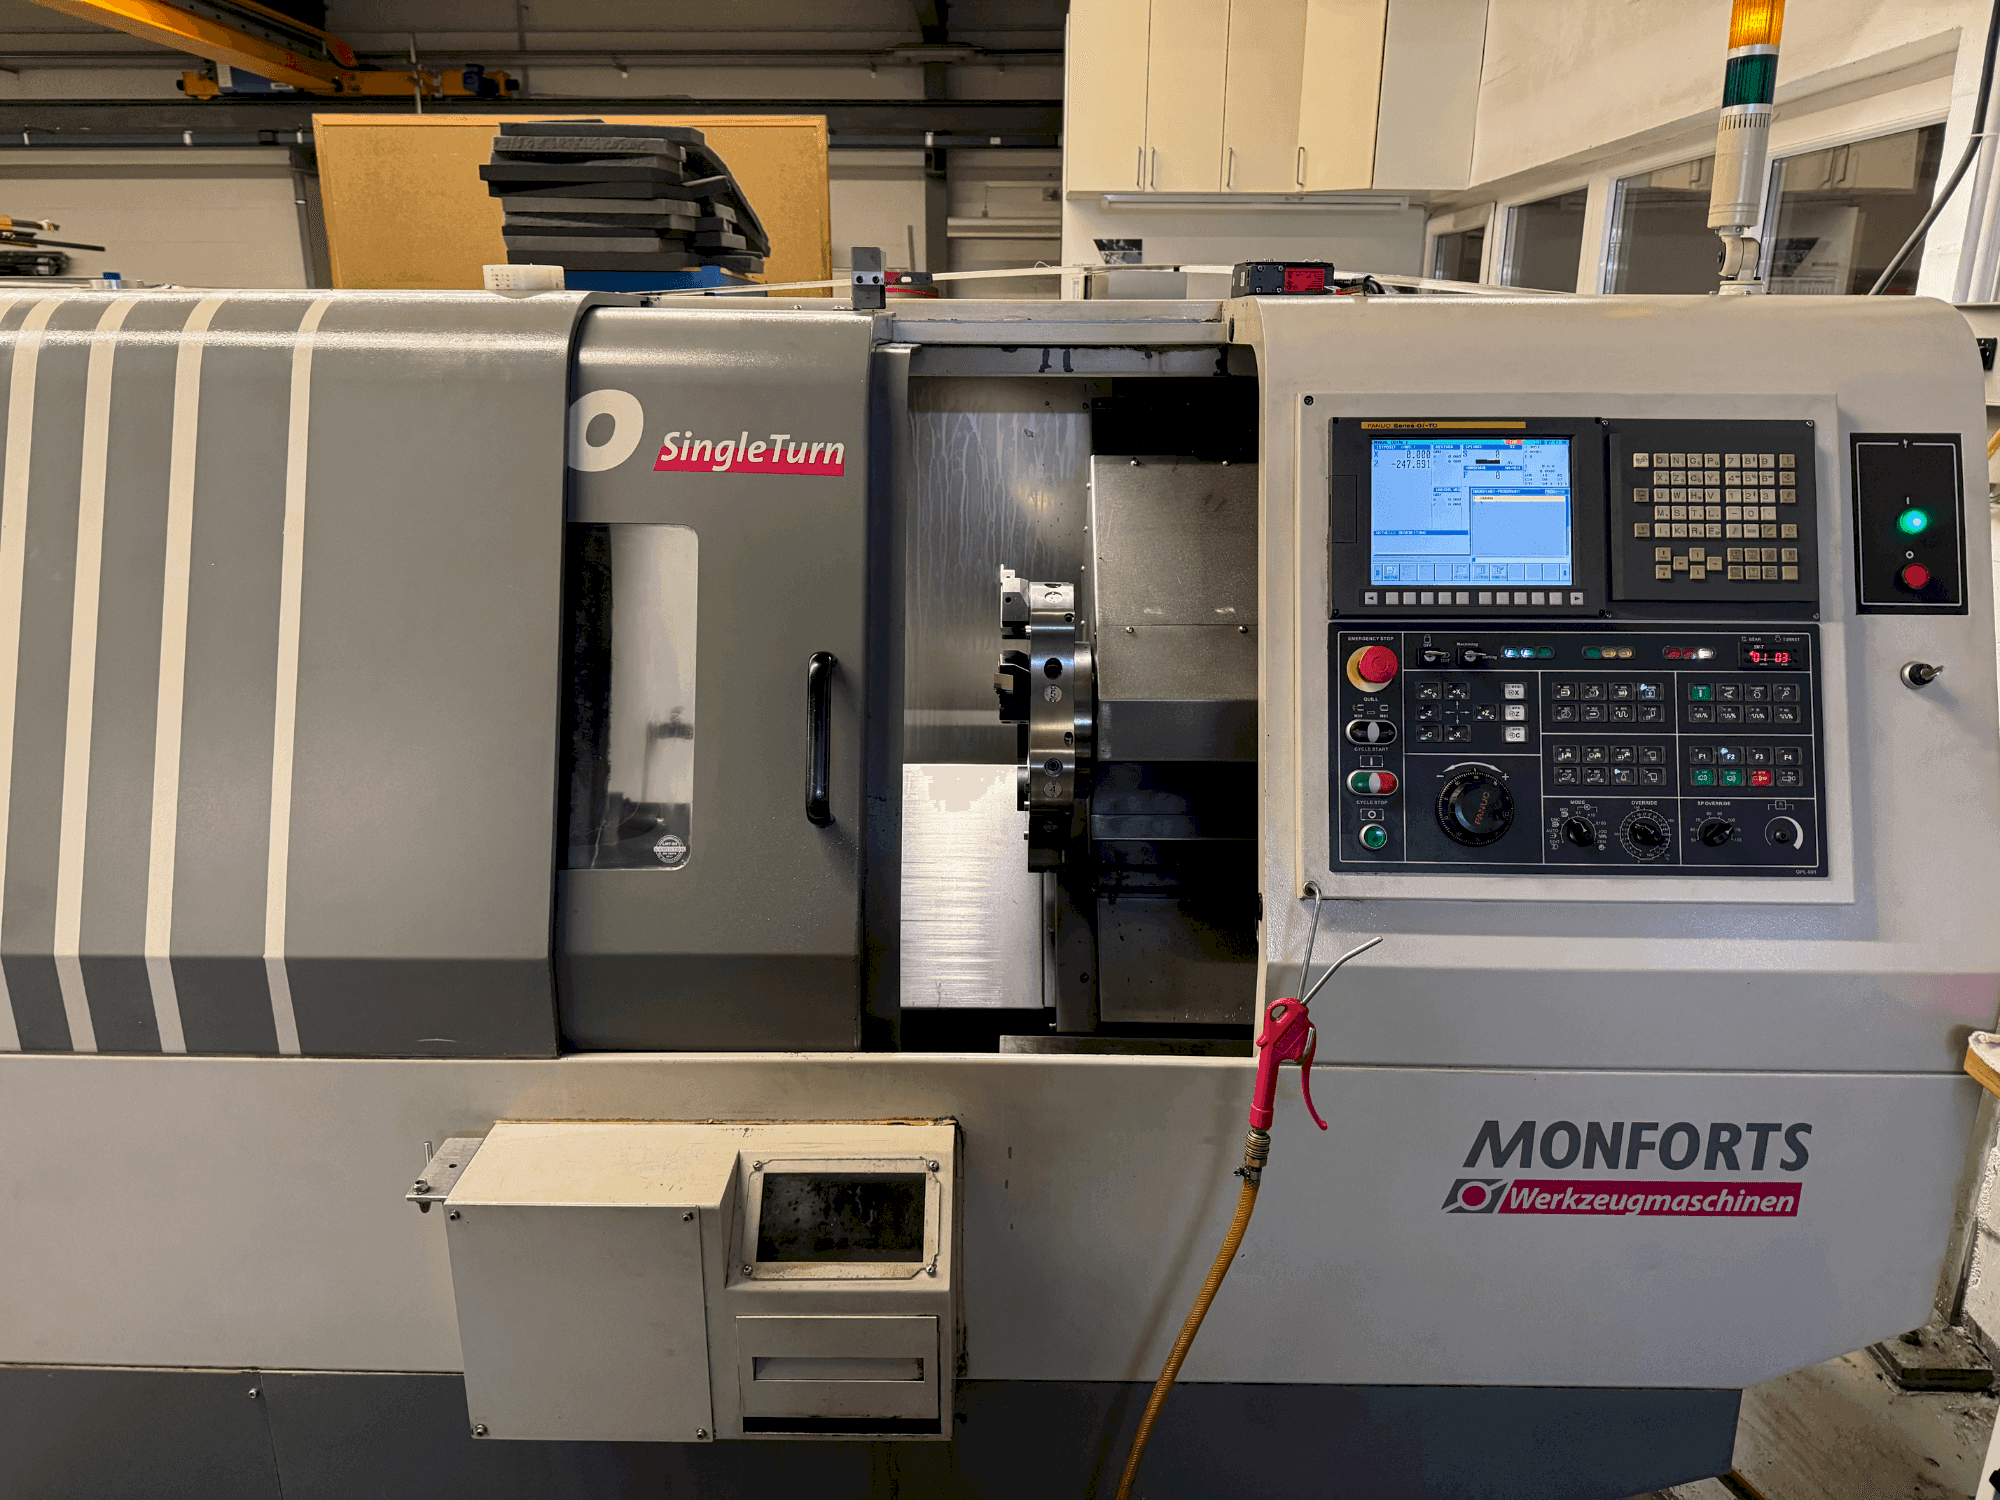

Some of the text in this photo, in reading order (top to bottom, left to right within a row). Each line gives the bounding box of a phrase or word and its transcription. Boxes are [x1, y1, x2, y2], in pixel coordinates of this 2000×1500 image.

[661, 431, 845, 472] SingleTurn
[1406, 450, 1431, 459] 0.000
[1474, 791, 1490, 825] FANUC
[1463, 1120, 1813, 1172] MONFORTS
[1511, 1186, 1795, 1215] Werkzeugmaschinen
